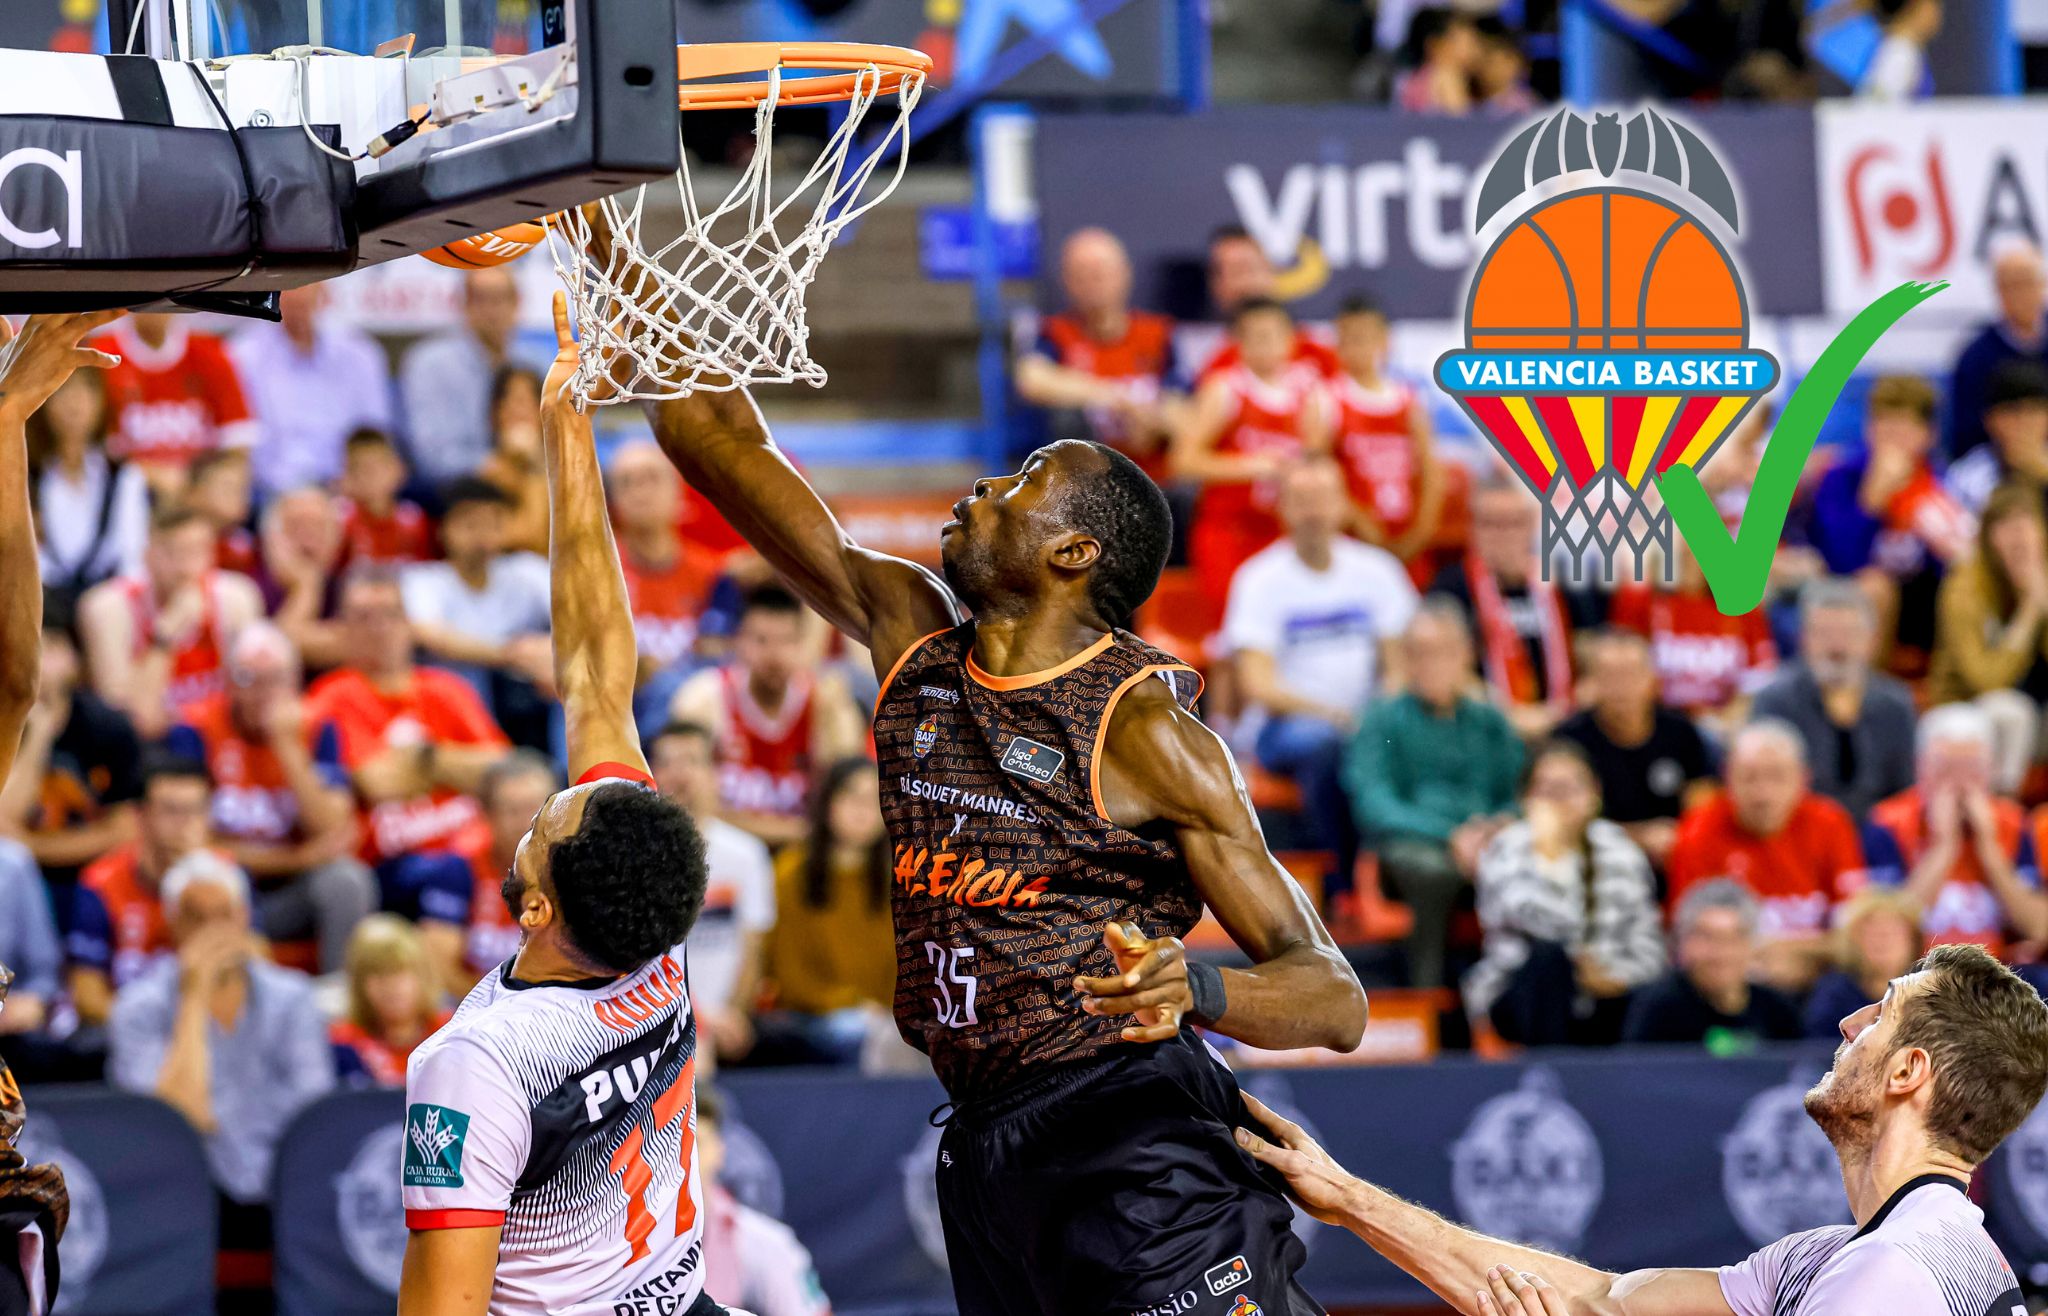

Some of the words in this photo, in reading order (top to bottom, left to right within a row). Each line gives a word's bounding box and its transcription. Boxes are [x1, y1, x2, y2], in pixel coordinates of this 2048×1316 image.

[1225, 138, 1468, 268] virt
[915, 730, 938, 743] BAXI
[1011, 747, 1033, 760] liga
[1007, 757, 1050, 778] endesa
[900, 772, 961, 804] BÁSQUET
[981, 831, 1047, 848] AGUAS,
[988, 847, 1011, 860] DE
[1016, 847, 1037, 860] LA
[1054, 900, 1111, 926] QUART
[924, 941, 979, 1029] 35
[406, 1165, 424, 1176] CAJA
[1213, 1270, 1241, 1291] acb
